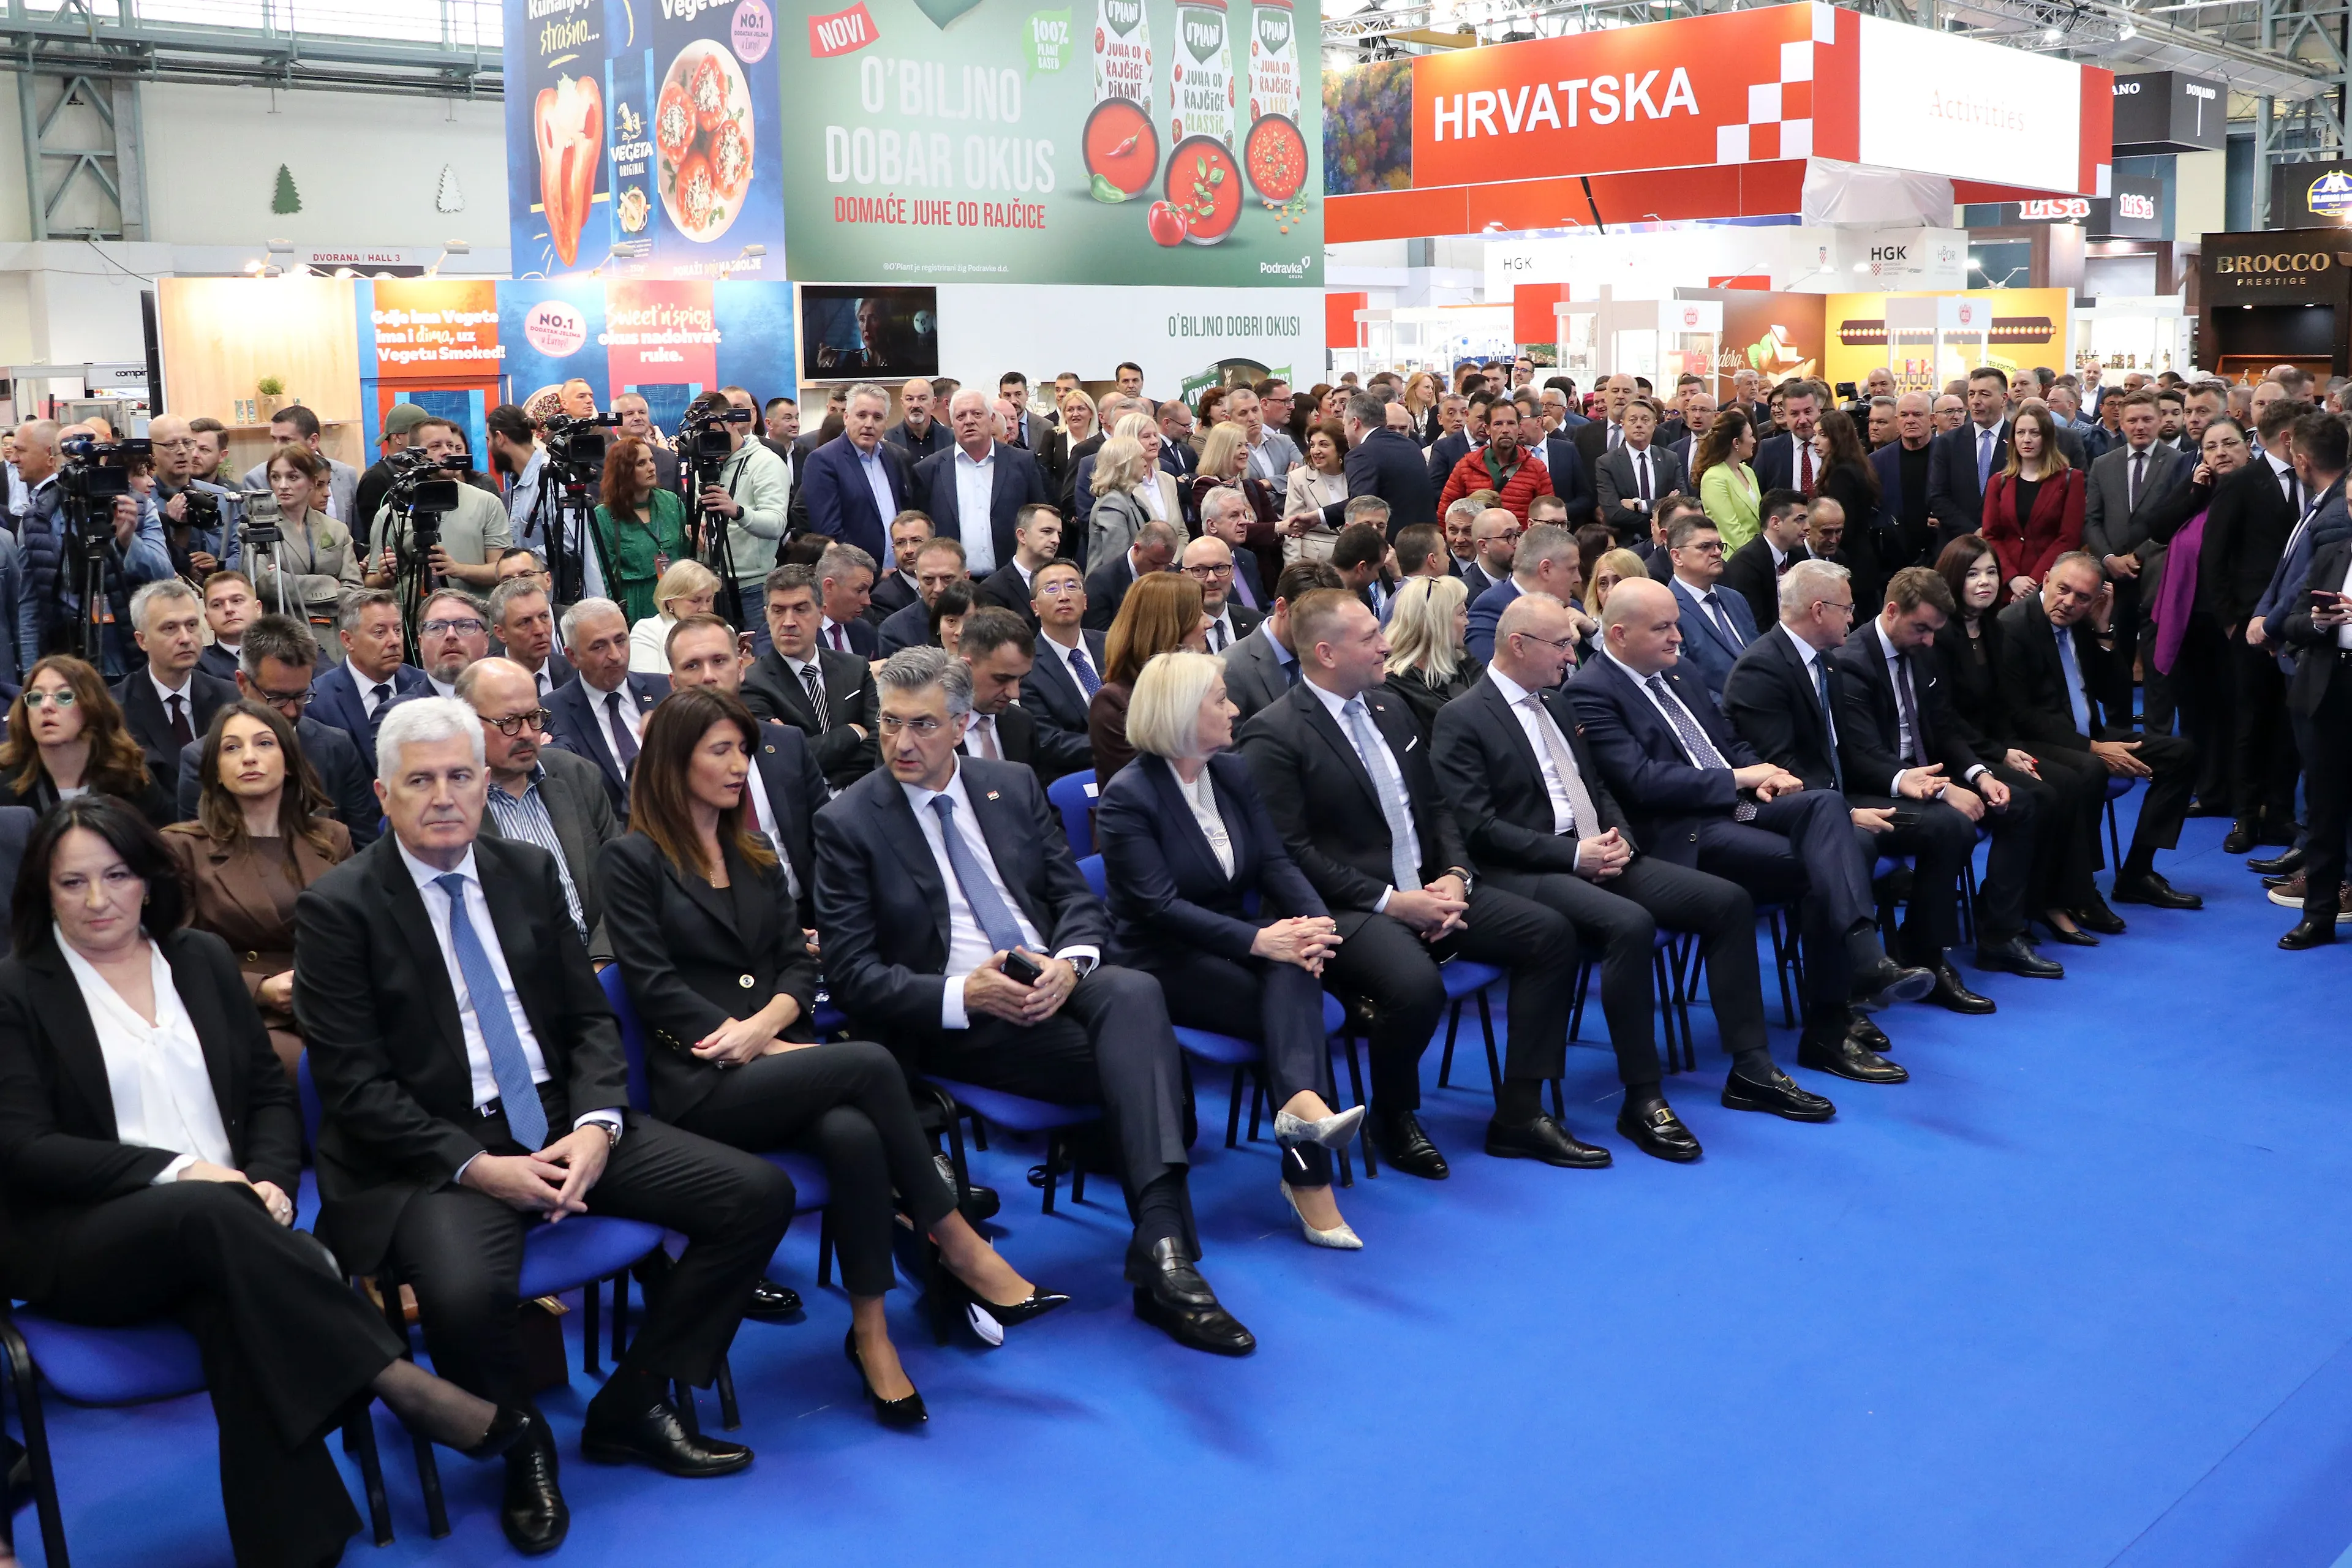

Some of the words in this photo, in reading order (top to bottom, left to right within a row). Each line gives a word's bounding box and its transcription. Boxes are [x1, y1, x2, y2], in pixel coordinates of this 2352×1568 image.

[740, 13, 764, 29] NO.1
[540, 15, 600, 56] strašno...
[817, 13, 865, 52] NOVI
[1031, 17, 1069, 45] 100%
[1186, 21, 1220, 47] O'PLANT
[1261, 20, 1287, 41] O'PLANT
[1038, 43, 1059, 56] PLANT
[1107, 42, 1129, 58] JUHA
[1132, 45, 1141, 59] OD
[1038, 56, 1060, 70] BASED
[1261, 60, 1280, 74] JUHA
[1282, 62, 1291, 75] OD
[1185, 69, 1210, 88] JUHA
[1213, 72, 1223, 89] OD
[861, 56, 1022, 124] O'BILJNO
[2186, 83, 2216, 100] DOMANO
[1434, 67, 1700, 142] HRVATSKA
[1929, 89, 2024, 132] Activities
[826, 125, 953, 189] DOBAR
[963, 134, 1056, 194] OKUS
[619, 162, 645, 178] ORIGINAL
[834, 192, 907, 225] DOMAĆE
[911, 200, 952, 226] JUHE
[957, 200, 979, 227] OD
[983, 197, 1046, 229] RAJČICE
[2021, 198, 2089, 217] LiSa
[2122, 196, 2152, 217] LiSa
[313, 254, 360, 262] DVORANA
[368, 254, 392, 262] HALL
[1871, 246, 1907, 261] HGK
[957, 264, 967, 273] žig
[1260, 262, 1303, 273] Podravka
[1504, 257, 1532, 270] HGK
[2215, 252, 2331, 274] BROCCO
[2237, 277, 2307, 286] PRESTIGE
[410, 309, 441, 323] ima
[442, 309, 500, 327] Vegete
[540, 313, 573, 330] NO.1
[1168, 313, 1223, 337] O'BILJNO
[1227, 315, 1262, 336] DOBRI
[1266, 315, 1301, 336] OKUSI
[375, 329, 407, 344] ima
[408, 328, 414, 344] i
[415, 325, 456, 345] dima,
[456, 330, 477, 342] uz
[530, 326, 558, 334] DODATAK
[597, 330, 639, 345] okus
[377, 346, 437, 364] Vegetu
[439, 344, 507, 361] Smoked!
[640, 347, 684, 363] ruke.
